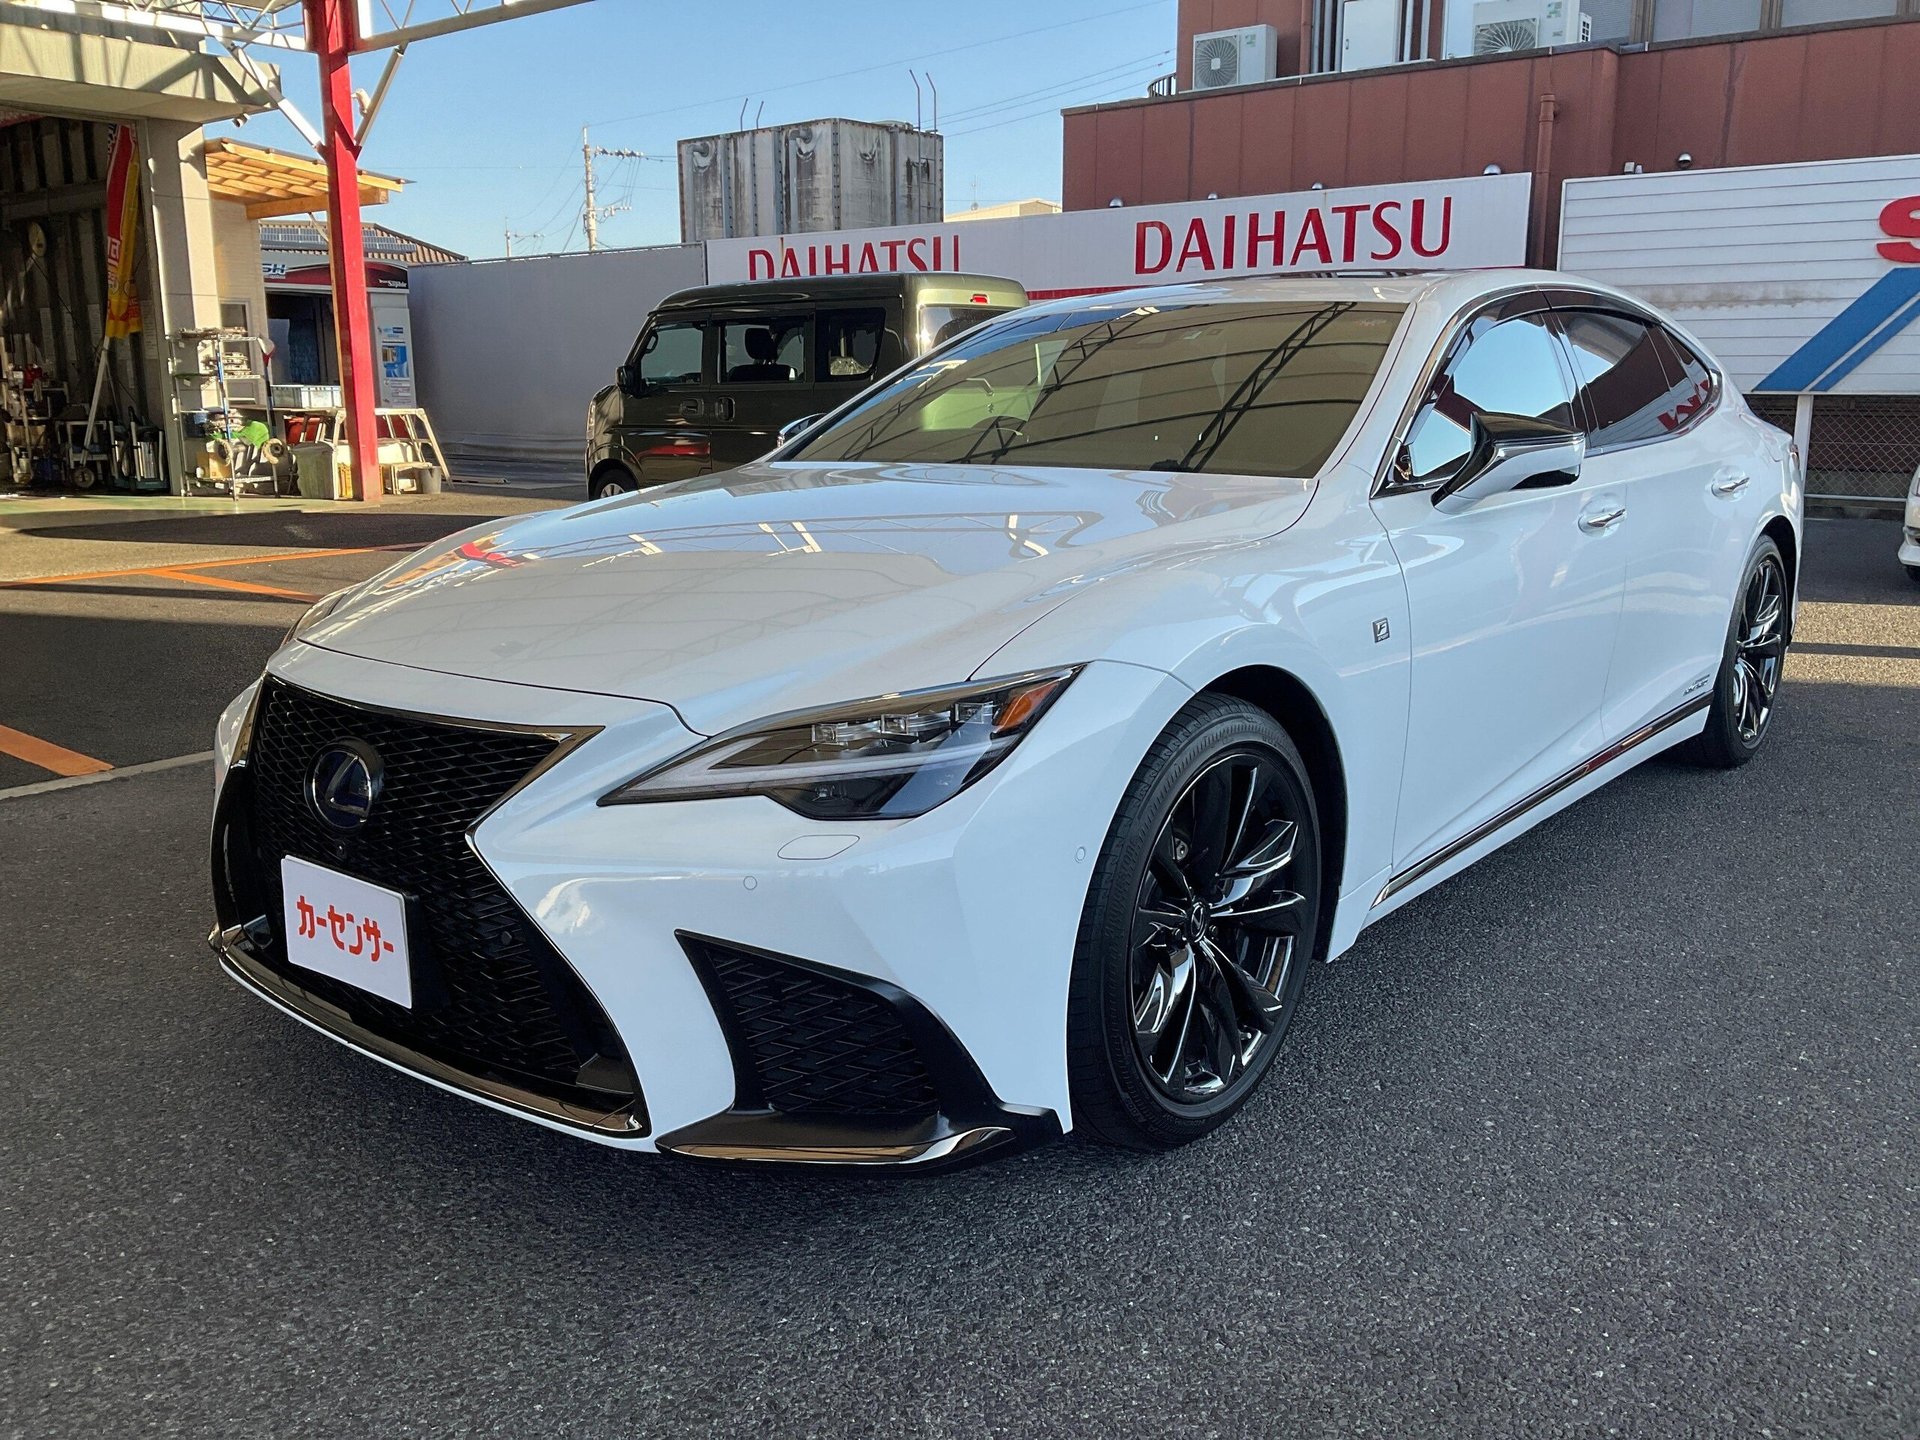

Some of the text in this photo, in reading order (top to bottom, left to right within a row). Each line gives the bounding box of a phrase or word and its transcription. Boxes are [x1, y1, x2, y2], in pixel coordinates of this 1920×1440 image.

[749, 235, 959, 281] DAIHATSU
[1135, 196, 1452, 274] DAIHATSU
[297, 895, 395, 962] カーセンサー
